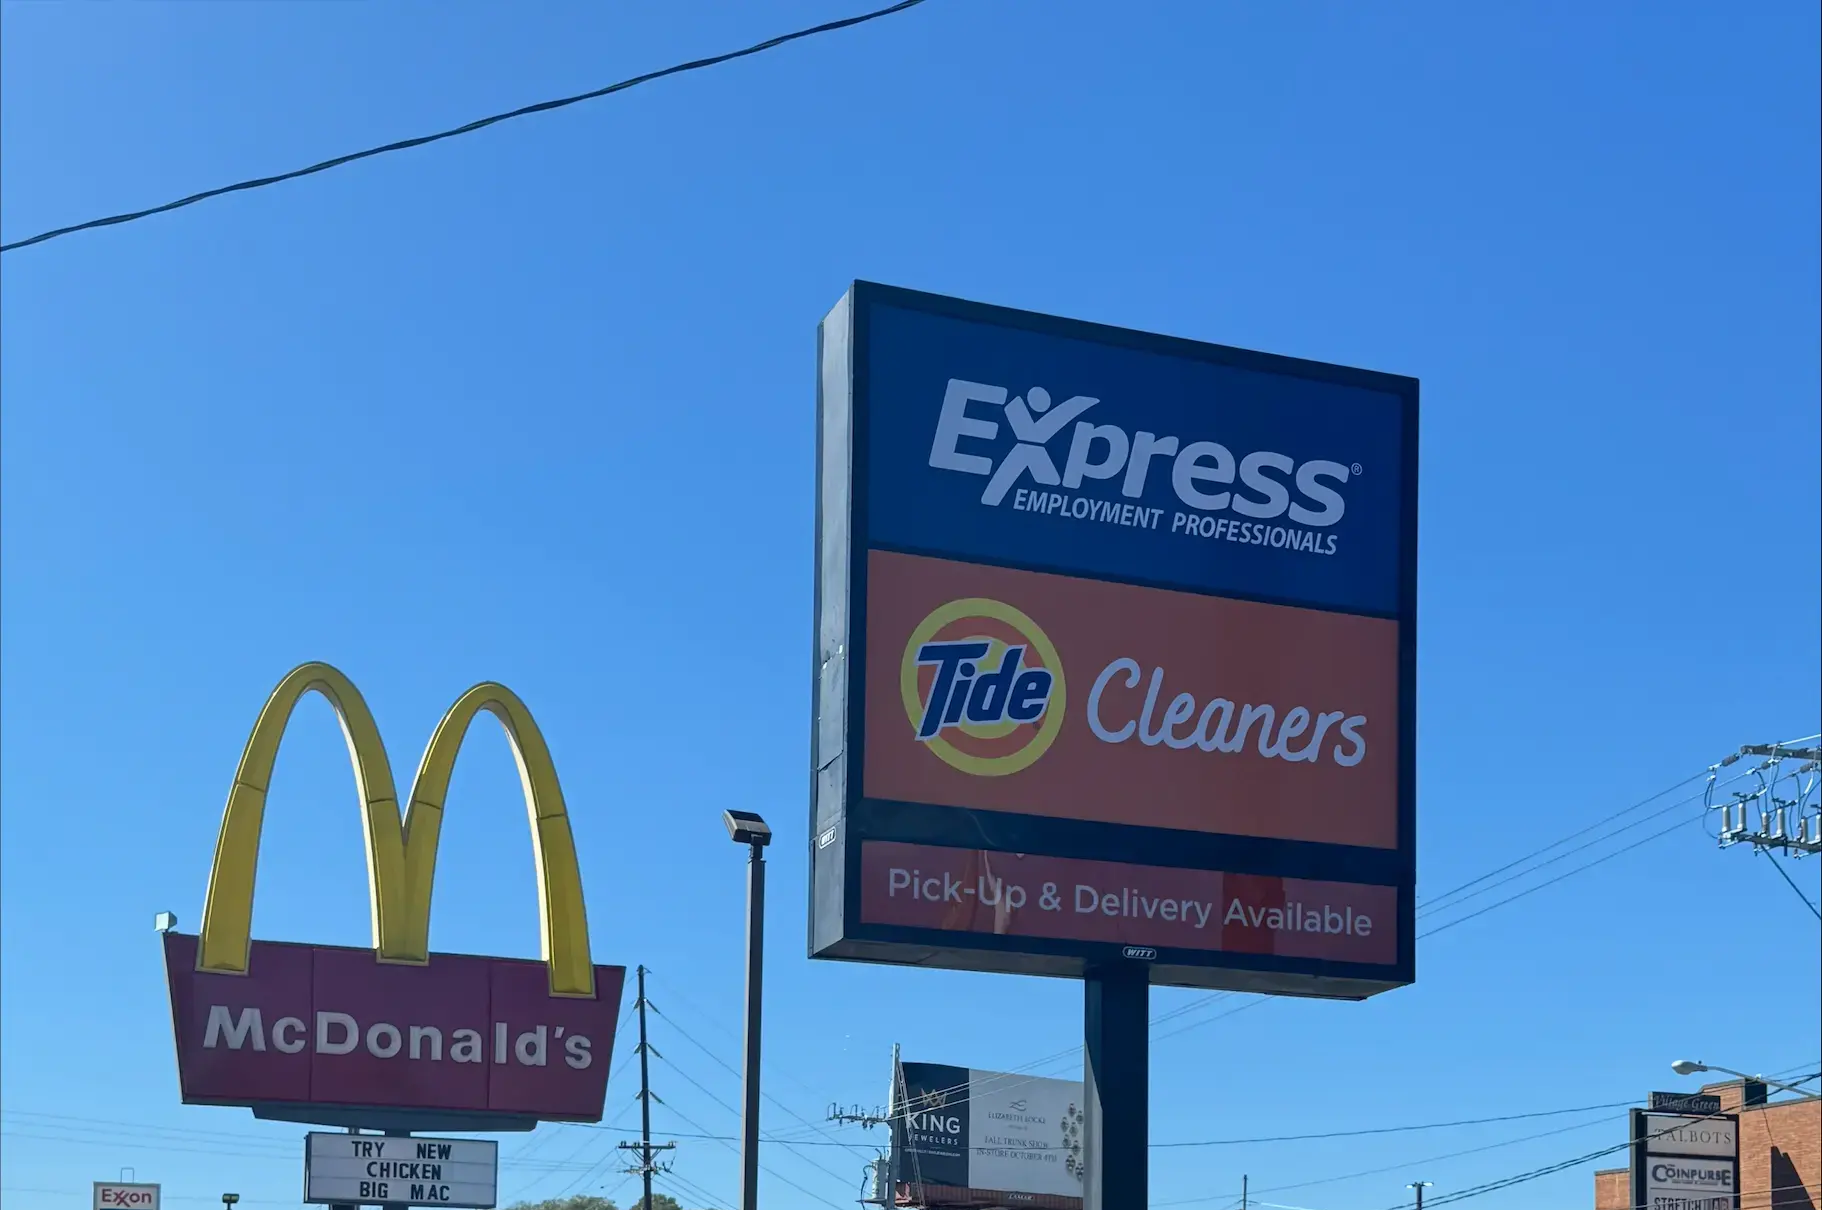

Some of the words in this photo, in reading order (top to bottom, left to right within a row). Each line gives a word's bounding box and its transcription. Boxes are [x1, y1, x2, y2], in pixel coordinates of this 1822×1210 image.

[928, 378, 1347, 526] Express
[1013, 489, 1164, 530] EMPLOYMENT
[1172, 512, 1338, 556] PROFESSIONALS
[914, 641, 1053, 742] Tide
[1087, 658, 1367, 767] Cleaners
[888, 868, 1027, 910] Pick-Up
[1039, 882, 1062, 911] &
[1075, 884, 1212, 929] Delivery
[1224, 896, 1373, 937] Available
[1126, 948, 1153, 957] WITT
[203, 1005, 593, 1070] McDonald's
[1691, 1098, 1719, 1112] Green
[907, 1113, 960, 1134] KING
[1654, 1128, 1732, 1145] TALBOTS
[352, 1140, 385, 1157] TRY
[416, 1143, 452, 1160] NEW
[366, 1162, 441, 1180] CHICKEN
[101, 1188, 152, 1208] Exxon
[360, 1181, 388, 1198] BIG
[410, 1184, 450, 1201] MAC
